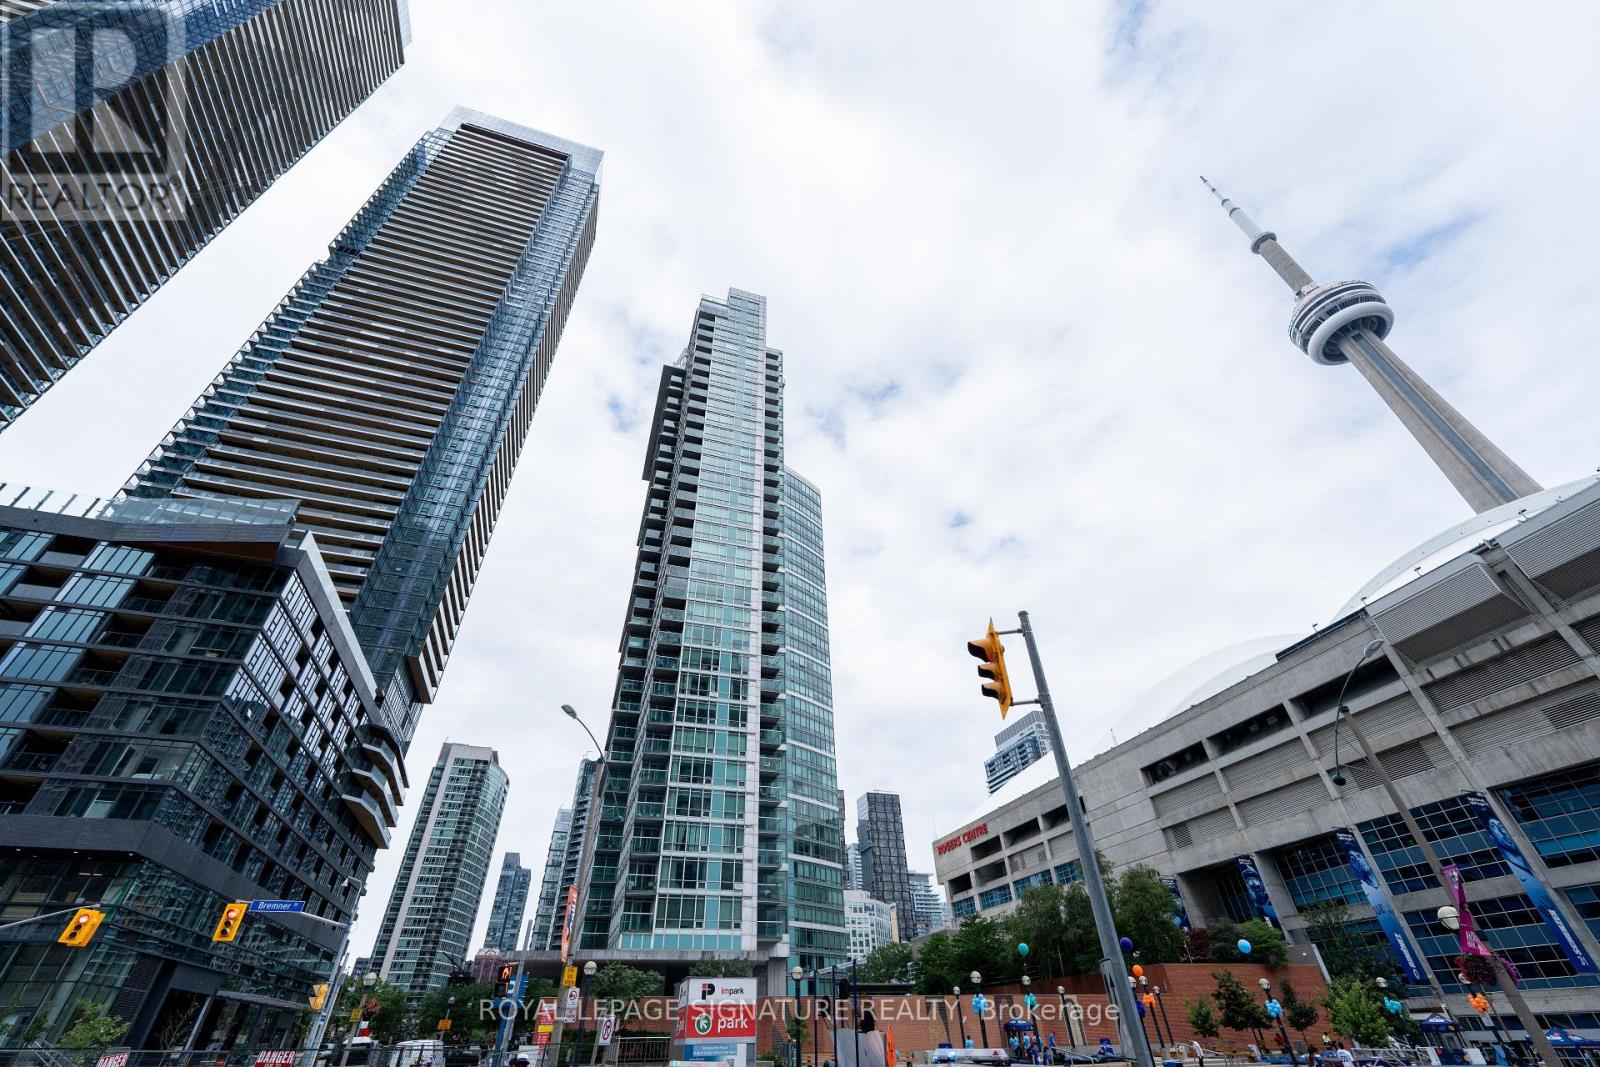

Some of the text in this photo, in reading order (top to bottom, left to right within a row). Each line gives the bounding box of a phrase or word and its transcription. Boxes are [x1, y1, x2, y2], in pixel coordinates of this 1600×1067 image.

[936, 822, 989, 855] ROGERS CENTRE
[257, 901, 292, 910] Bremner
[720, 986, 744, 997] impark
[717, 1013, 749, 1034] park
[257, 1050, 296, 1064] DANGER
